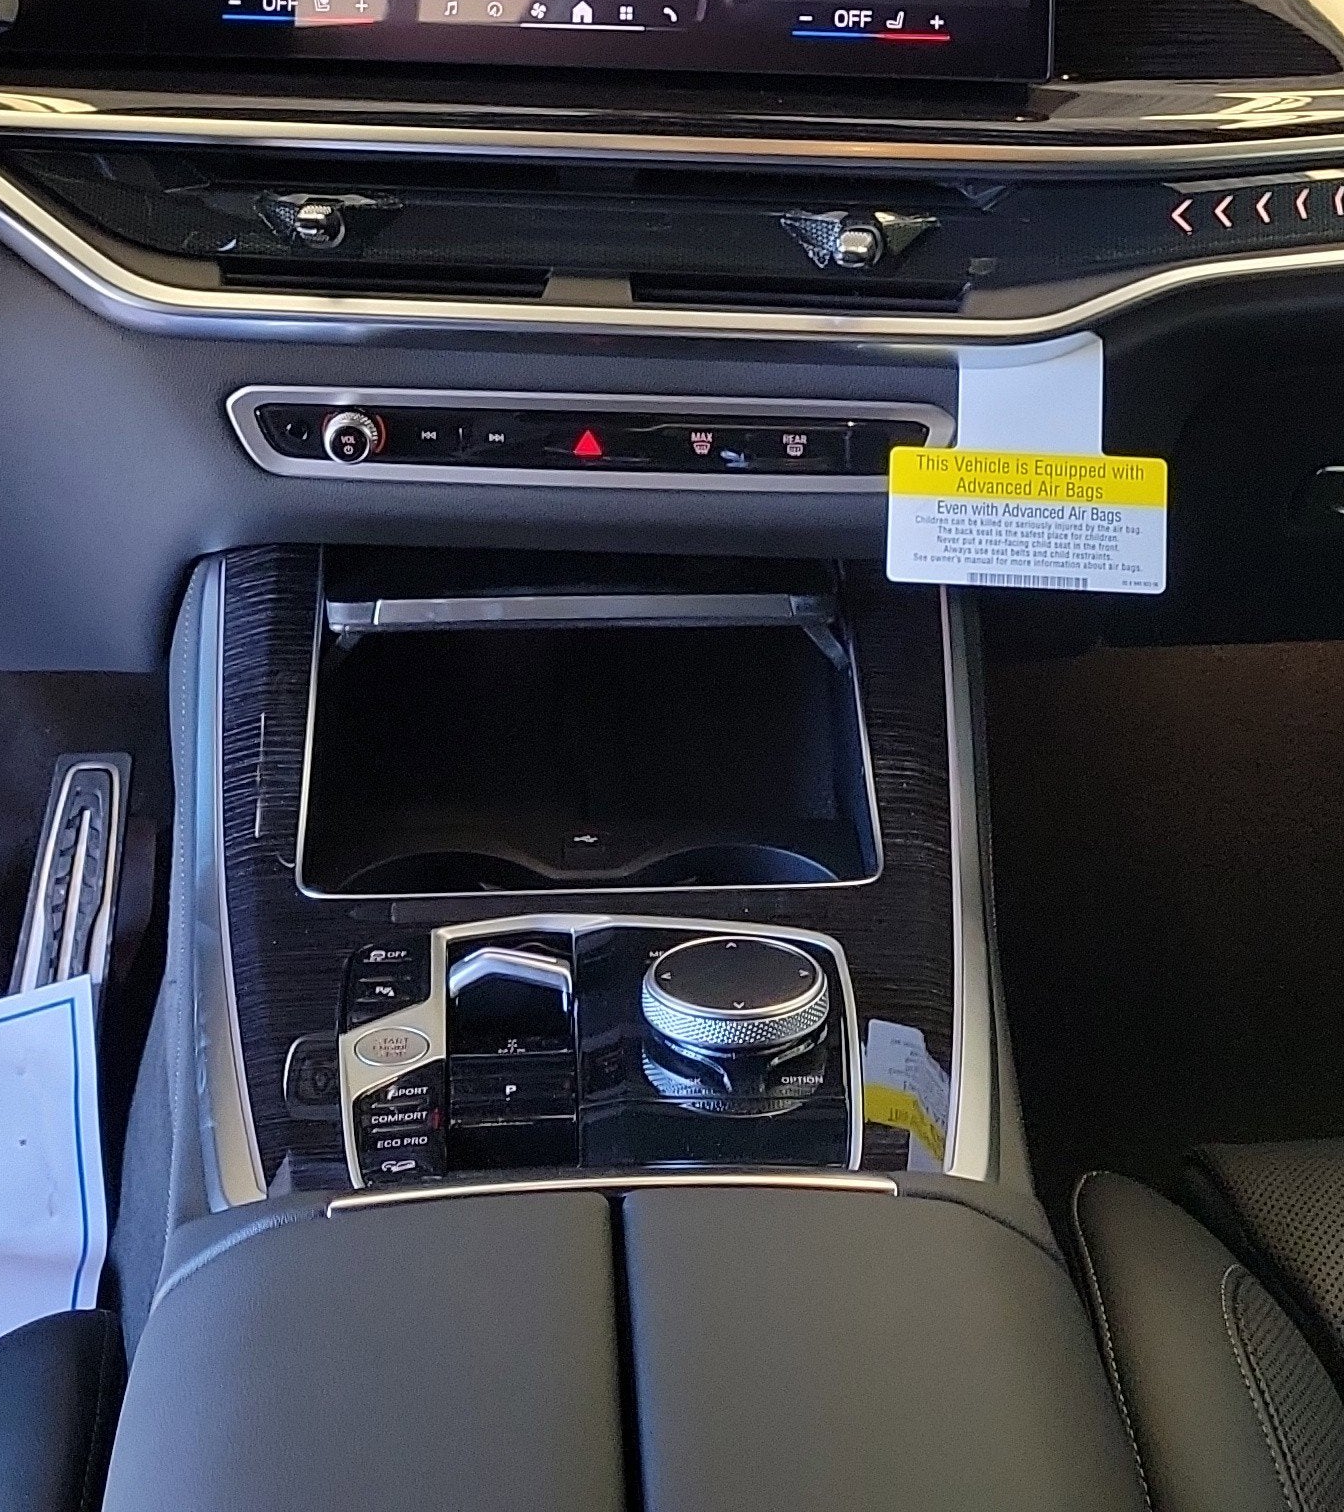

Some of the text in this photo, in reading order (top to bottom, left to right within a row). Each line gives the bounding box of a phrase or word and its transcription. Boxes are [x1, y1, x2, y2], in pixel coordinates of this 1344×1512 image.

[834, 9, 873, 28] OFF
[341, 435, 356, 444] VOL
[691, 432, 713, 443] MAX
[916, 454, 1145, 481] This Vehicle is Equipped with
[956, 476, 1104, 502] Advanced Air Bags
[937, 500, 1122, 525] Even with Advanced Air Bags
[915, 515, 949, 525] Children
[951, 517, 966, 526] can
[968, 518, 978, 526] be
[980, 519, 1002, 528] killed
[1016, 520, 1052, 531] seriously
[1055, 522, 1084, 532] injured
[1085, 523, 1095, 533] by
[1097, 524, 1110, 533] the
[1113, 524, 1123, 533] air
[938, 526, 952, 535] The
[955, 526, 974, 536] back
[976, 527, 993, 537] seat
[1005, 529, 1018, 538] the
[1020, 529, 1045, 539] safest
[1047, 530, 1068, 541] place
[1070, 531, 1082, 541] for
[937, 535, 960, 545] Never
[962, 536, 976, 546] put
[1031, 540, 1052, 549] child
[1054, 541, 1071, 550] seat
[1083, 542, 1096, 551] the
[943, 545, 972, 556] Always
[974, 547, 989, 555] use
[991, 547, 1008, 556] seat
[1032, 549, 1048, 558] and
[1050, 550, 1070, 559] child
[913, 552, 928, 562] See
[930, 553, 962, 564] owner's
[964, 555, 994, 565] manual
[996, 556, 1008, 565] for
[1010, 557, 1032, 566] more
[1033, 558, 1081, 569] information
[1083, 561, 1106, 570] about
[781, 1075, 824, 1085] OPTION
[371, 1111, 429, 1125] COMFORT
[376, 1136, 428, 1149] ECO PRO
